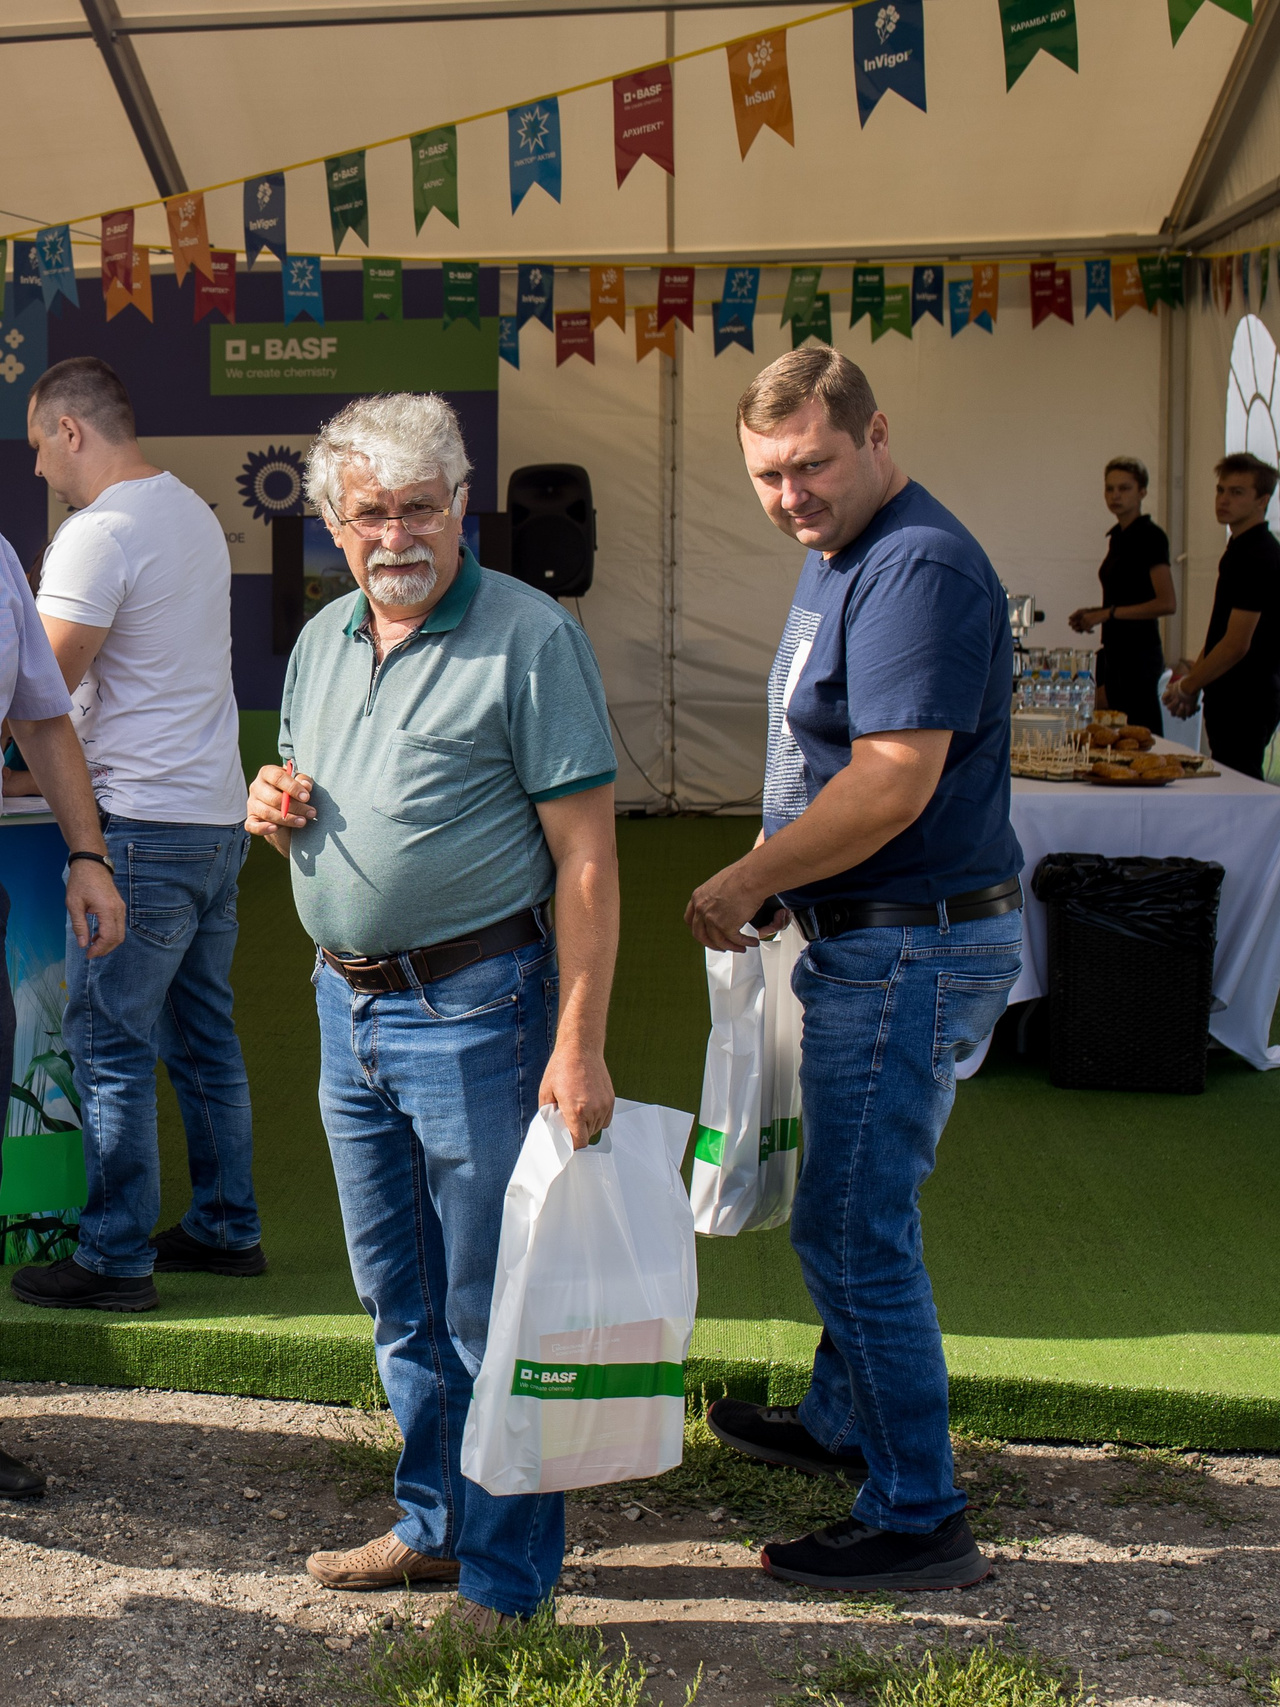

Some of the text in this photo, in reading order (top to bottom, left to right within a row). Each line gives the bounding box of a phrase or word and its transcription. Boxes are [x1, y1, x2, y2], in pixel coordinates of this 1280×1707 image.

[1050, 9, 1067, 23] ДУО
[863, 51, 910, 73] InVigor
[636, 84, 662, 100] BASF
[744, 89, 776, 107] InSun
[428, 143, 448, 155] BASF
[341, 166, 359, 179] BASF
[249, 219, 277, 232] InVigor
[265, 337, 337, 360] BASF
[225, 365, 337, 380] We create chemistry
[541, 1371, 578, 1384] BASF
